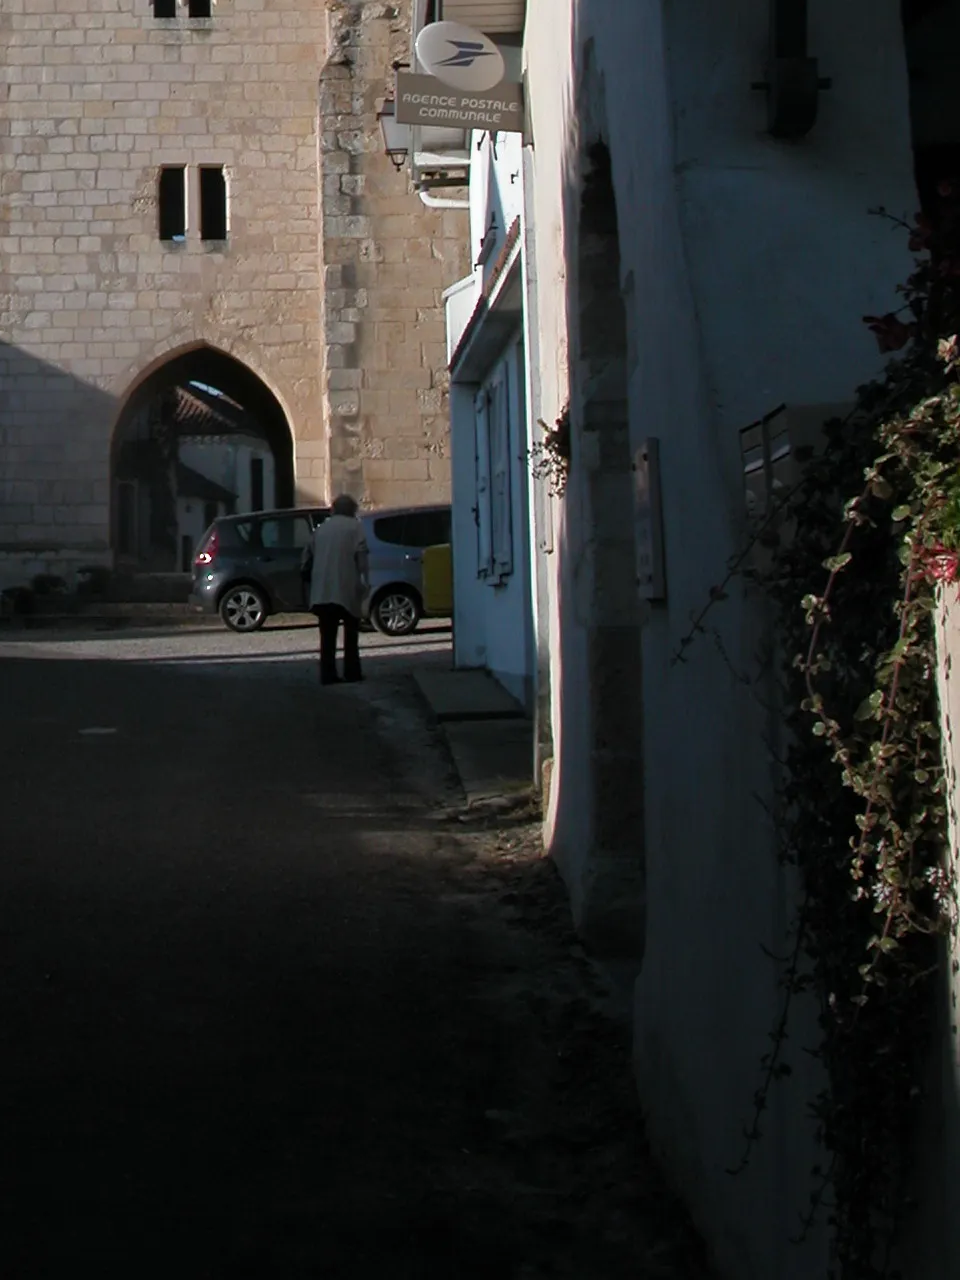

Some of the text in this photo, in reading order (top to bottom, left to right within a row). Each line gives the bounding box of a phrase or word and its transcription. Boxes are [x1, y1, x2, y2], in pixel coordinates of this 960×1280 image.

[402, 93, 518, 112] AGENCE POSTALE
[419, 107, 501, 123] COMMUNALE
